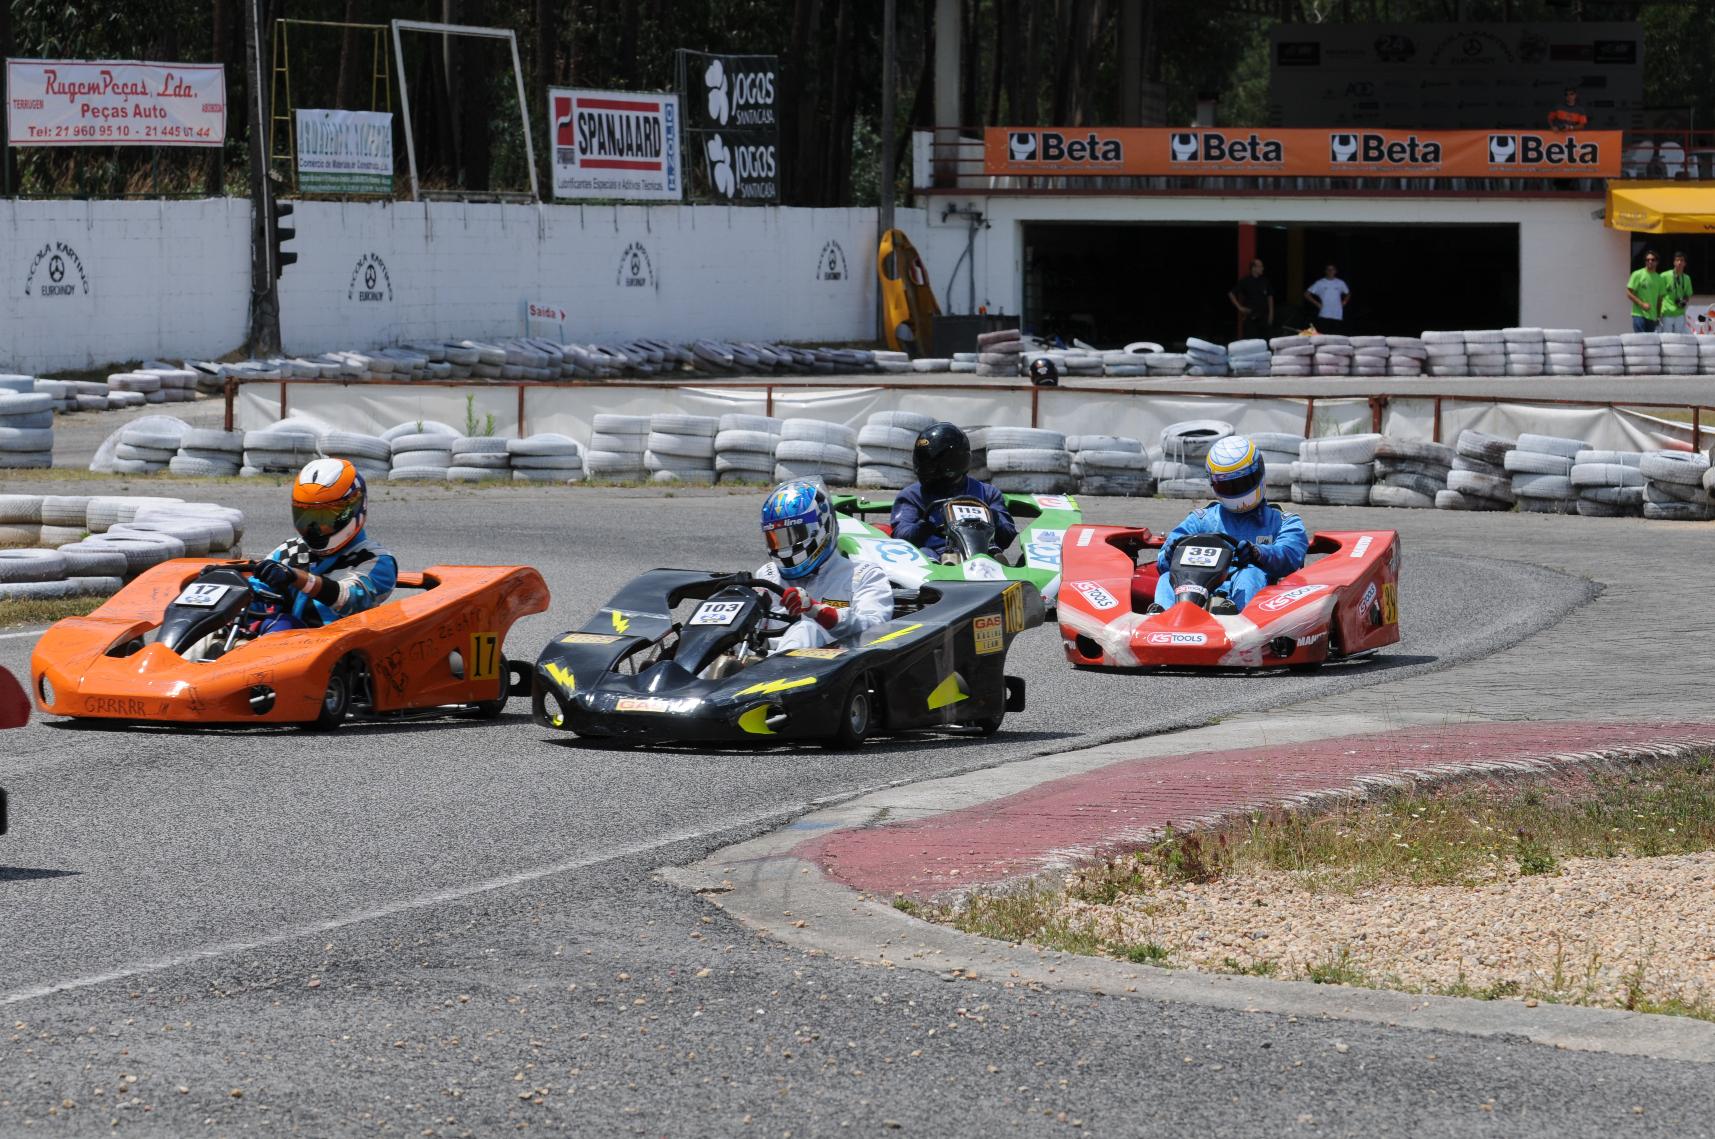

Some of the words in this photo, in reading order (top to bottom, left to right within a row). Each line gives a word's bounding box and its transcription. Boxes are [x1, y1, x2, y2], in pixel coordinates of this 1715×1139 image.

[81, 103, 128, 122] Peças
[133, 104, 167, 119] Auto
[28, 126, 52, 137] Tel:
[56, 126, 69, 137] 21
[73, 125, 96, 137] 960
[99, 125, 113, 137] 95
[116, 125, 130, 137] 10
[145, 125, 158, 137] 21
[161, 125, 181, 137] 445
[578, 111, 661, 158] SPANJAARD
[1041, 133, 1122, 162] Beta
[1203, 133, 1283, 162] Beta
[1362, 134, 1441, 163] Beta
[1521, 135, 1598, 164] Beta
[57, 241, 90, 294] KARTING
[957, 507, 983, 515] 115
[1189, 547, 1217, 557] 39
[195, 585, 221, 594] 17
[704, 603, 740, 613] 103
[1265, 597, 1292, 610] KS
[975, 616, 1001, 630] GAS
[1172, 634, 1203, 643] TOOLS
[473, 635, 497, 678] 17
